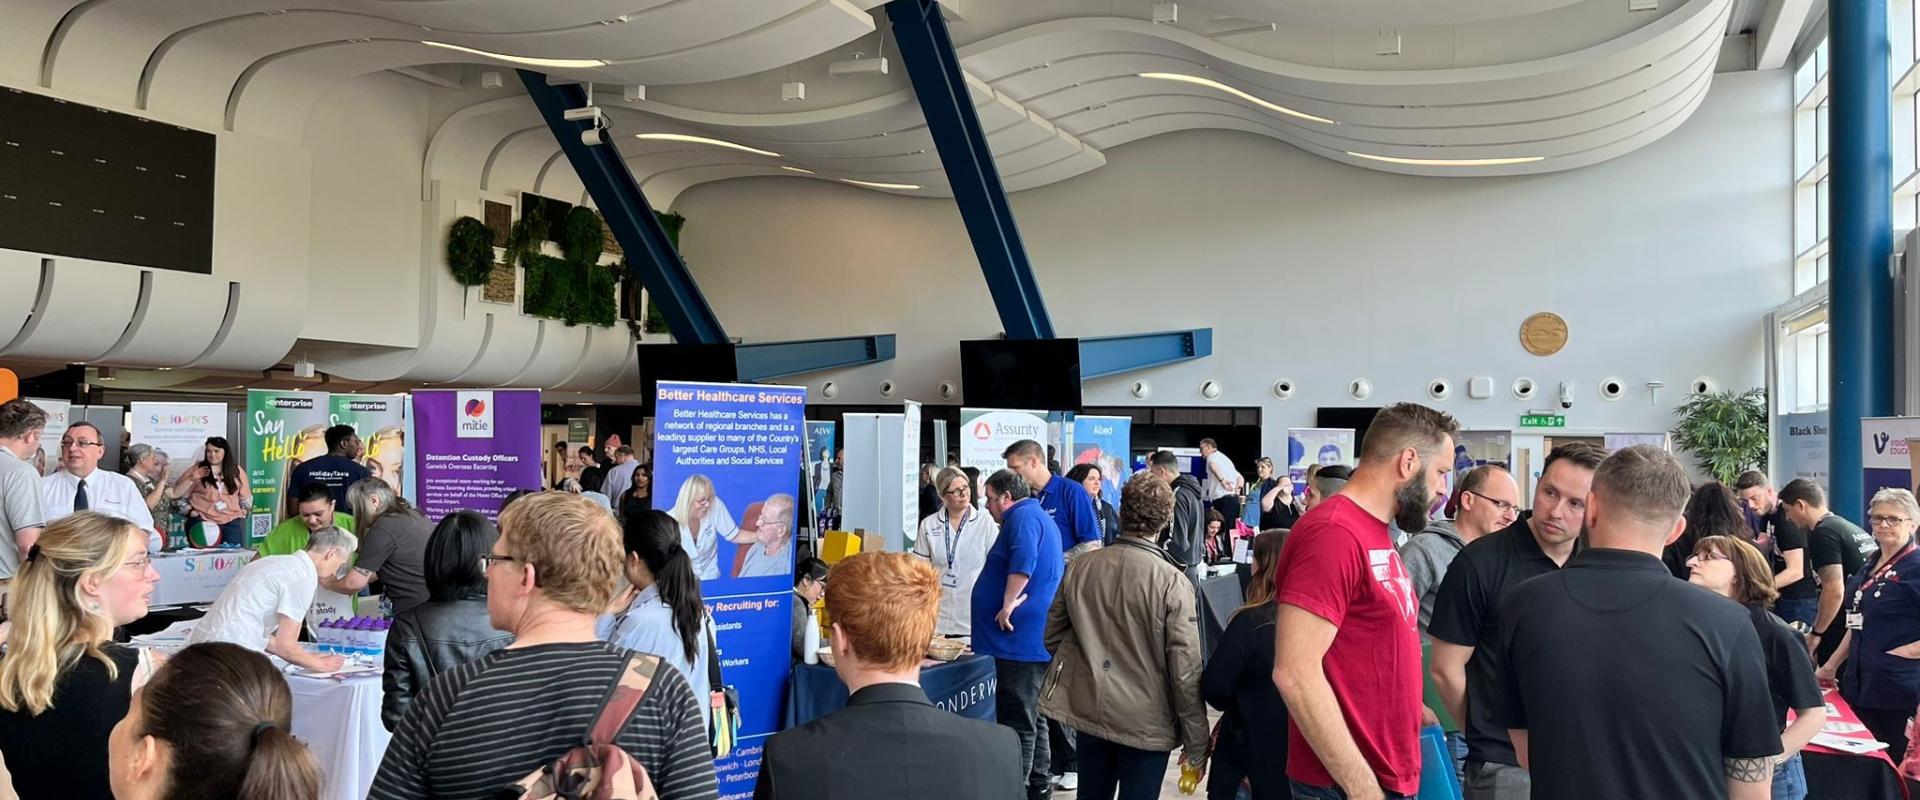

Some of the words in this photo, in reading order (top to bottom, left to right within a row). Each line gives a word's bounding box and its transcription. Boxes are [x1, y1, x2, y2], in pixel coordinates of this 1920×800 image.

[659, 389, 694, 400] Better
[697, 390, 756, 403] Healthcare
[758, 392, 803, 404] Services
[268, 399, 313, 408] enterprise
[341, 402, 386, 411] enterprise
[673, 408, 697, 418] Better
[698, 410, 737, 419] Healthcare
[738, 410, 768, 419] Services
[770, 411, 783, 420] has
[253, 410, 285, 443] Say
[462, 420, 488, 431] mitie
[664, 421, 695, 430] network
[696, 421, 704, 430] of
[705, 421, 734, 432] regional
[735, 422, 768, 431] branches
[769, 423, 782, 431] and
[1522, 417, 1537, 425] Exit
[995, 423, 1038, 438] Assurity
[1789, 426, 1812, 436] Black
[658, 432, 687, 443] leading
[687, 433, 717, 444] supplier
[718, 433, 725, 441] to
[726, 434, 746, 444] many
[747, 433, 755, 442] of
[756, 434, 768, 442] the
[769, 434, 799, 444] Country's
[262, 434, 305, 462] Hello
[672, 444, 699, 455] largest
[699, 444, 718, 454] Care
[768, 445, 788, 454] Local
[1890, 447, 1908, 455] EDUCA
[426, 453, 461, 461] Detention
[462, 454, 492, 463] Custody
[492, 454, 519, 462] Officers
[675, 456, 715, 465] Authorities
[716, 456, 730, 465] and
[730, 456, 753, 465] Social
[754, 456, 784, 465] Services
[716, 600, 763, 612] Recruiting
[764, 598, 780, 608] for:
[715, 621, 743, 632] ssistants
[722, 658, 750, 668] Workers
[935, 677, 998, 713] ONDERW
[744, 757, 763, 768] Lond
